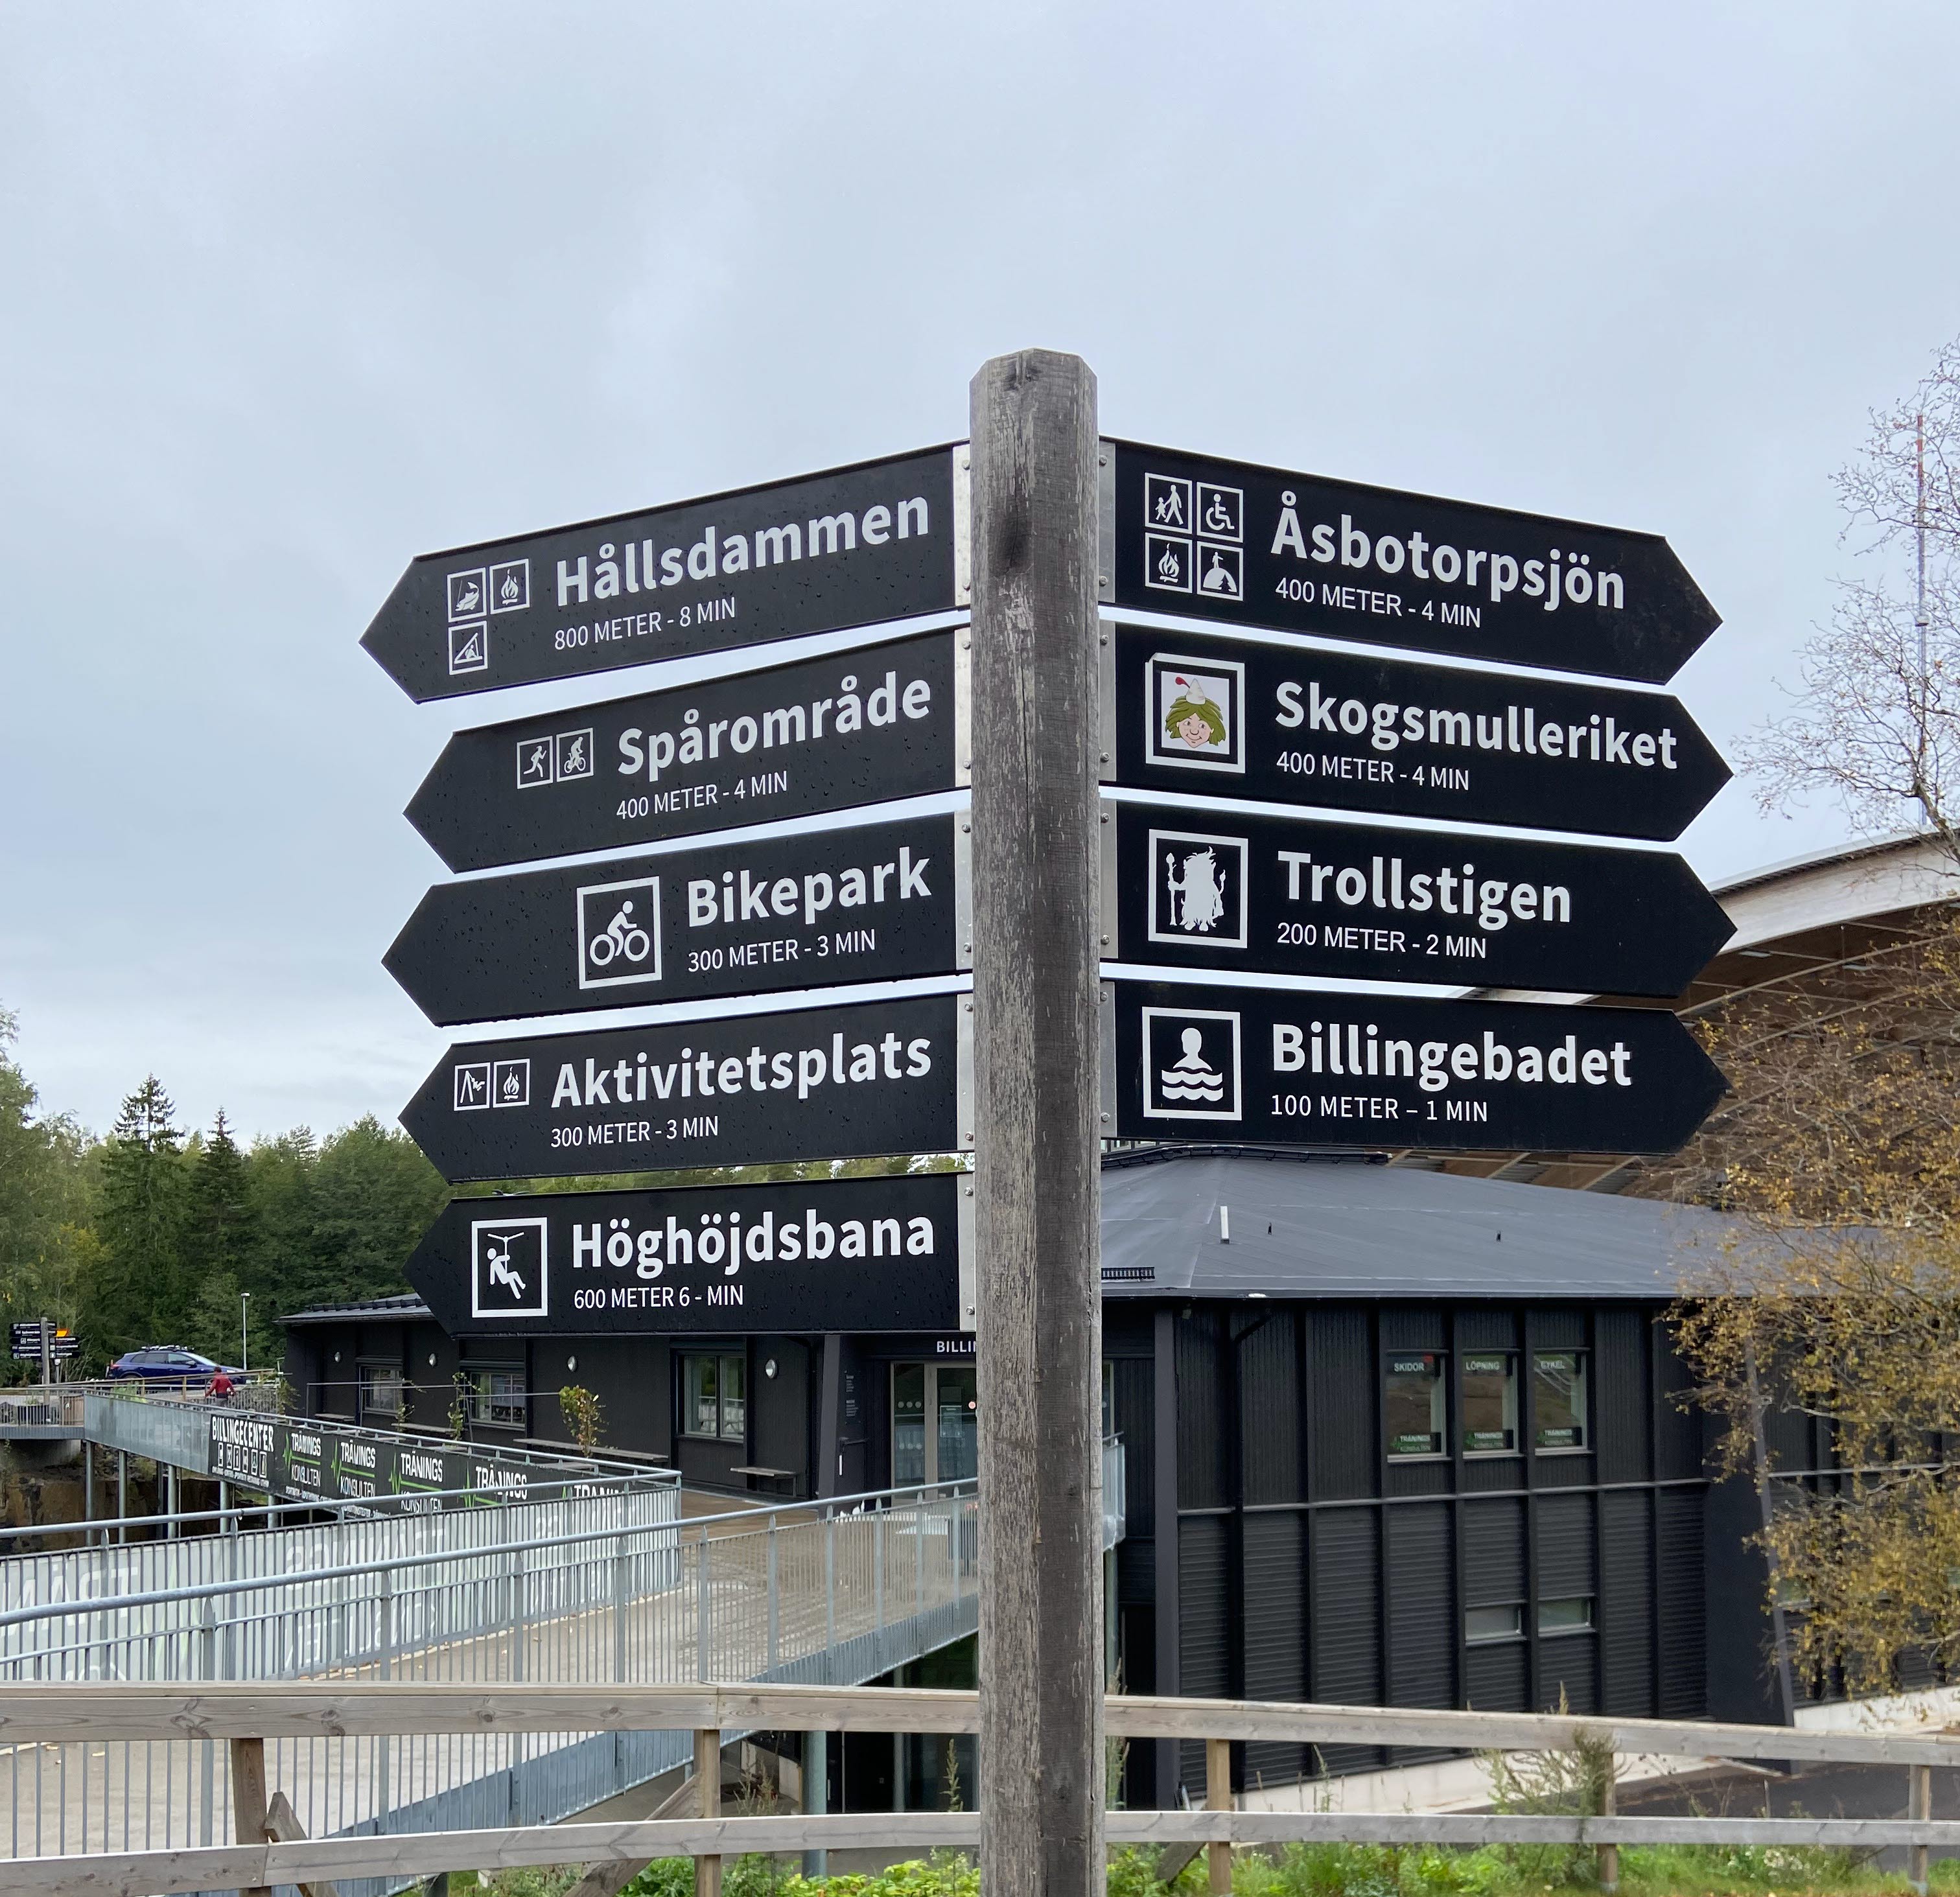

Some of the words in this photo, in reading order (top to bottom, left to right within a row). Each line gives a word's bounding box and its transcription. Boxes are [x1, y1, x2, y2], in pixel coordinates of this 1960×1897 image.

[557, 497, 928, 606] Hållsdammen
[1271, 491, 1624, 611] Åsbotorpsjön
[555, 626, 588, 649] 800
[595, 612, 661, 643] METER
[680, 607, 690, 627] 8
[697, 597, 734, 623] MIN
[1276, 577, 1314, 602] 400
[1323, 584, 1402, 616] METER
[1422, 601, 1434, 620] 4
[1441, 603, 1480, 627] MIN
[618, 671, 930, 782] Spårområde
[1276, 682, 1677, 770] Skogsmulleriket
[616, 797, 648, 819] 400
[655, 784, 718, 813] METER
[734, 779, 745, 798] 4
[752, 771, 786, 797] MIN
[1277, 752, 1314, 774] 400
[1323, 755, 1394, 783] METER
[1412, 766, 1425, 786] 4
[1432, 767, 1468, 790] MIN
[688, 846, 931, 927] Bikepark
[1278, 851, 1570, 930] Trollstigen
[688, 949, 723, 972] 300
[730, 940, 799, 967] METER
[817, 936, 828, 956] 3
[836, 929, 874, 954] MIN
[1278, 923, 1316, 945] 200
[1325, 926, 1405, 952] METER
[1427, 935, 1438, 955] 2
[1447, 936, 1486, 958] MIN
[552, 1033, 931, 1108] Aktivitetsplats
[1274, 1021, 1631, 1091] Billingebadet
[551, 1127, 582, 1147] 300
[589, 1122, 650, 1145] METER
[667, 1120, 677, 1139] 3
[684, 1116, 718, 1138] MIN
[1272, 1095, 1311, 1115] 100
[1321, 1096, 1398, 1119] METER
[1427, 1100, 1437, 1120] 1
[1447, 1100, 1486, 1121] MIN
[574, 1209, 933, 1279] Höghöjdsbana
[575, 1289, 605, 1309] 600
[612, 1287, 673, 1307] METER
[680, 1287, 690, 1306] 6
[708, 1285, 743, 1305] MIN
[1394, 1362, 1425, 1372] SKIDOR
[212, 1416, 274, 1452] BILLINGECENTER
[291, 1431, 321, 1456] TRÄNINGS
[340, 1439, 376, 1468] TRÄNINGS
[401, 1450, 443, 1482] TRÄNINGS
